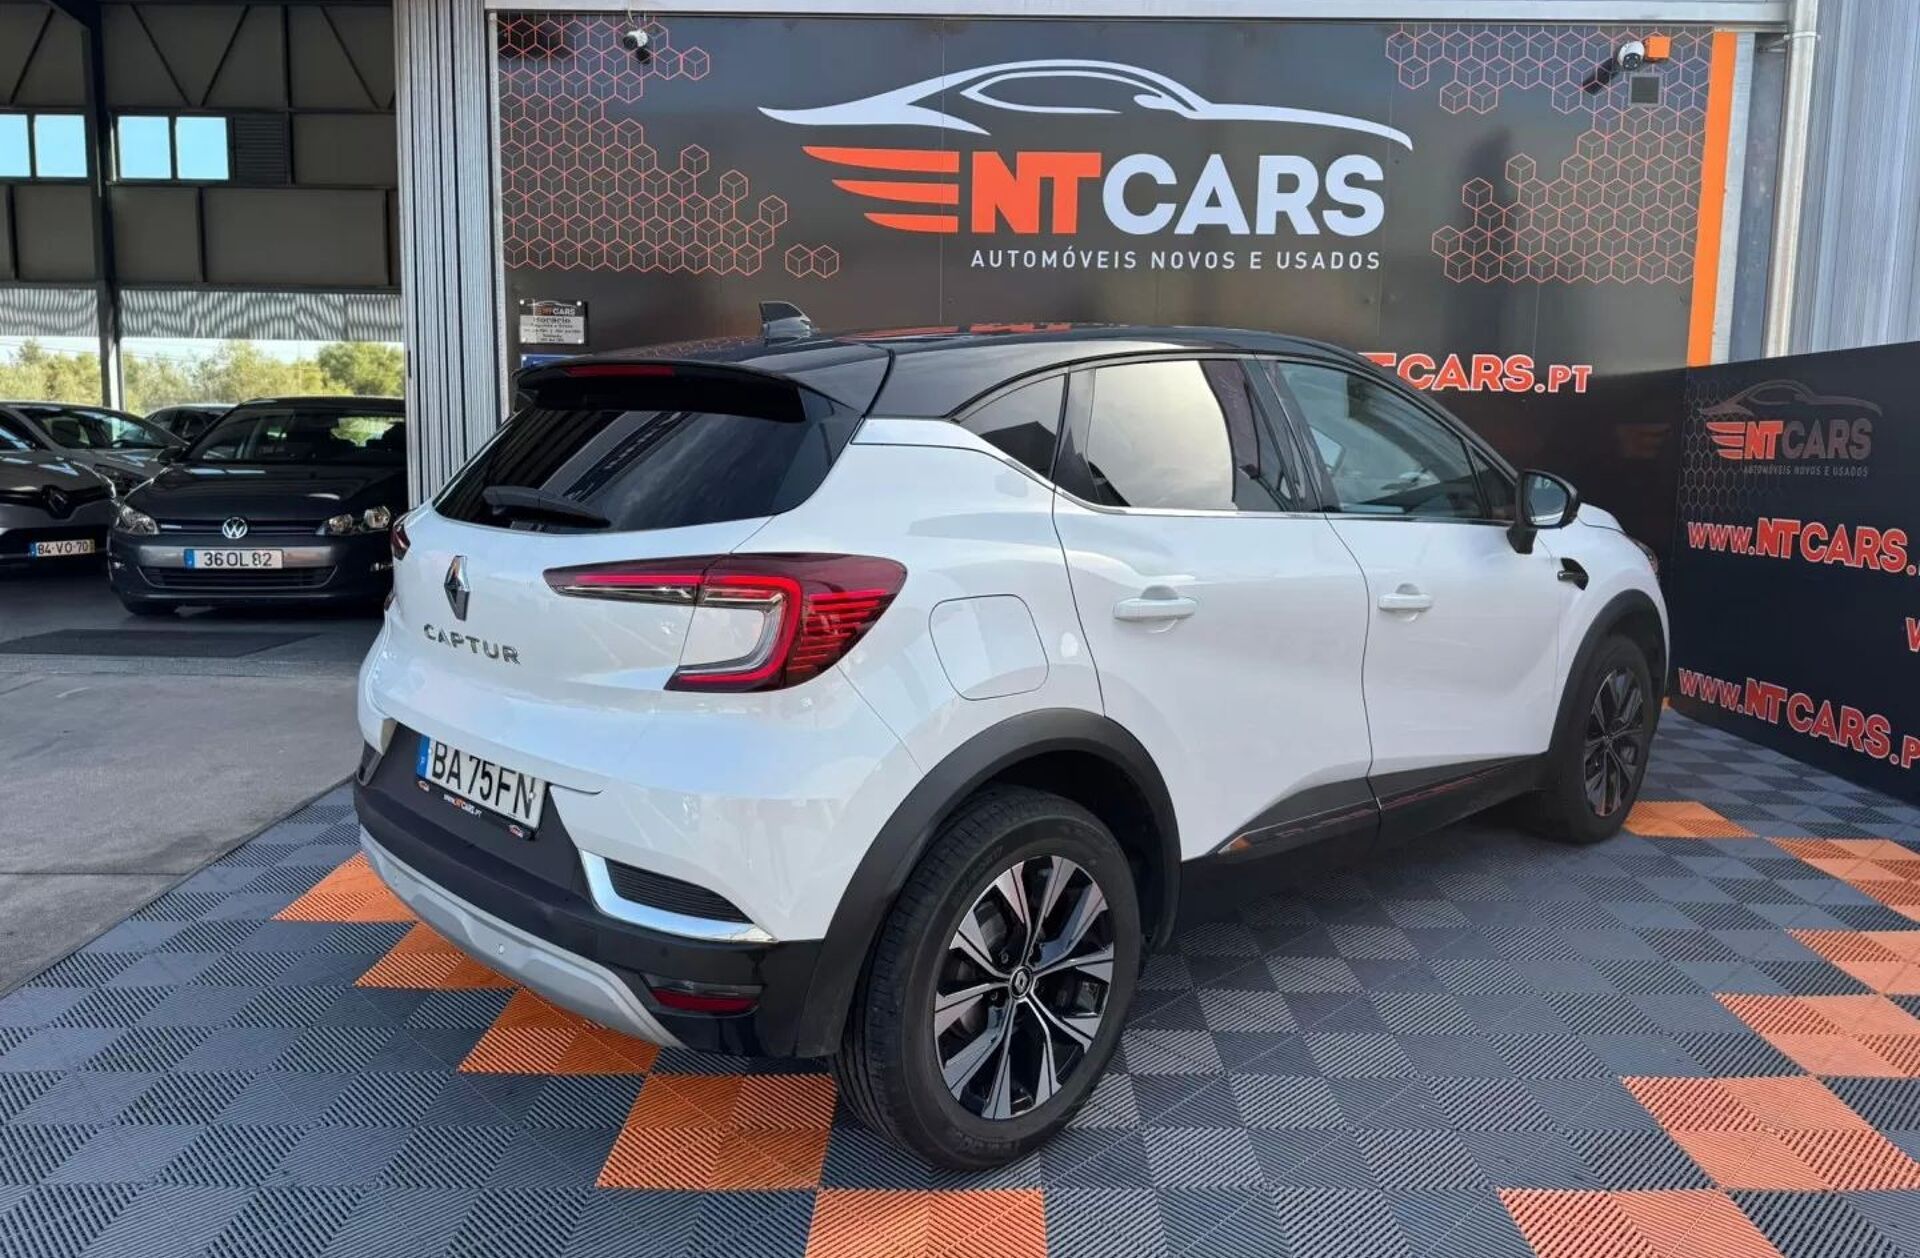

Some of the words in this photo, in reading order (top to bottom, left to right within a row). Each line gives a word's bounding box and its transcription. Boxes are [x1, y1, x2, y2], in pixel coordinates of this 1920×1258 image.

[971, 151, 1385, 236] NTCARS
[970, 246, 1137, 270] AUTOMÓVEIS
[1151, 251, 1236, 270] NOVOS
[1249, 251, 1262, 269] E
[1276, 251, 1381, 270] USADOS
[1743, 418, 1873, 461] NTCARS
[1832, 465, 1869, 478] USADOS
[423, 623, 521, 665] CAPTUR
